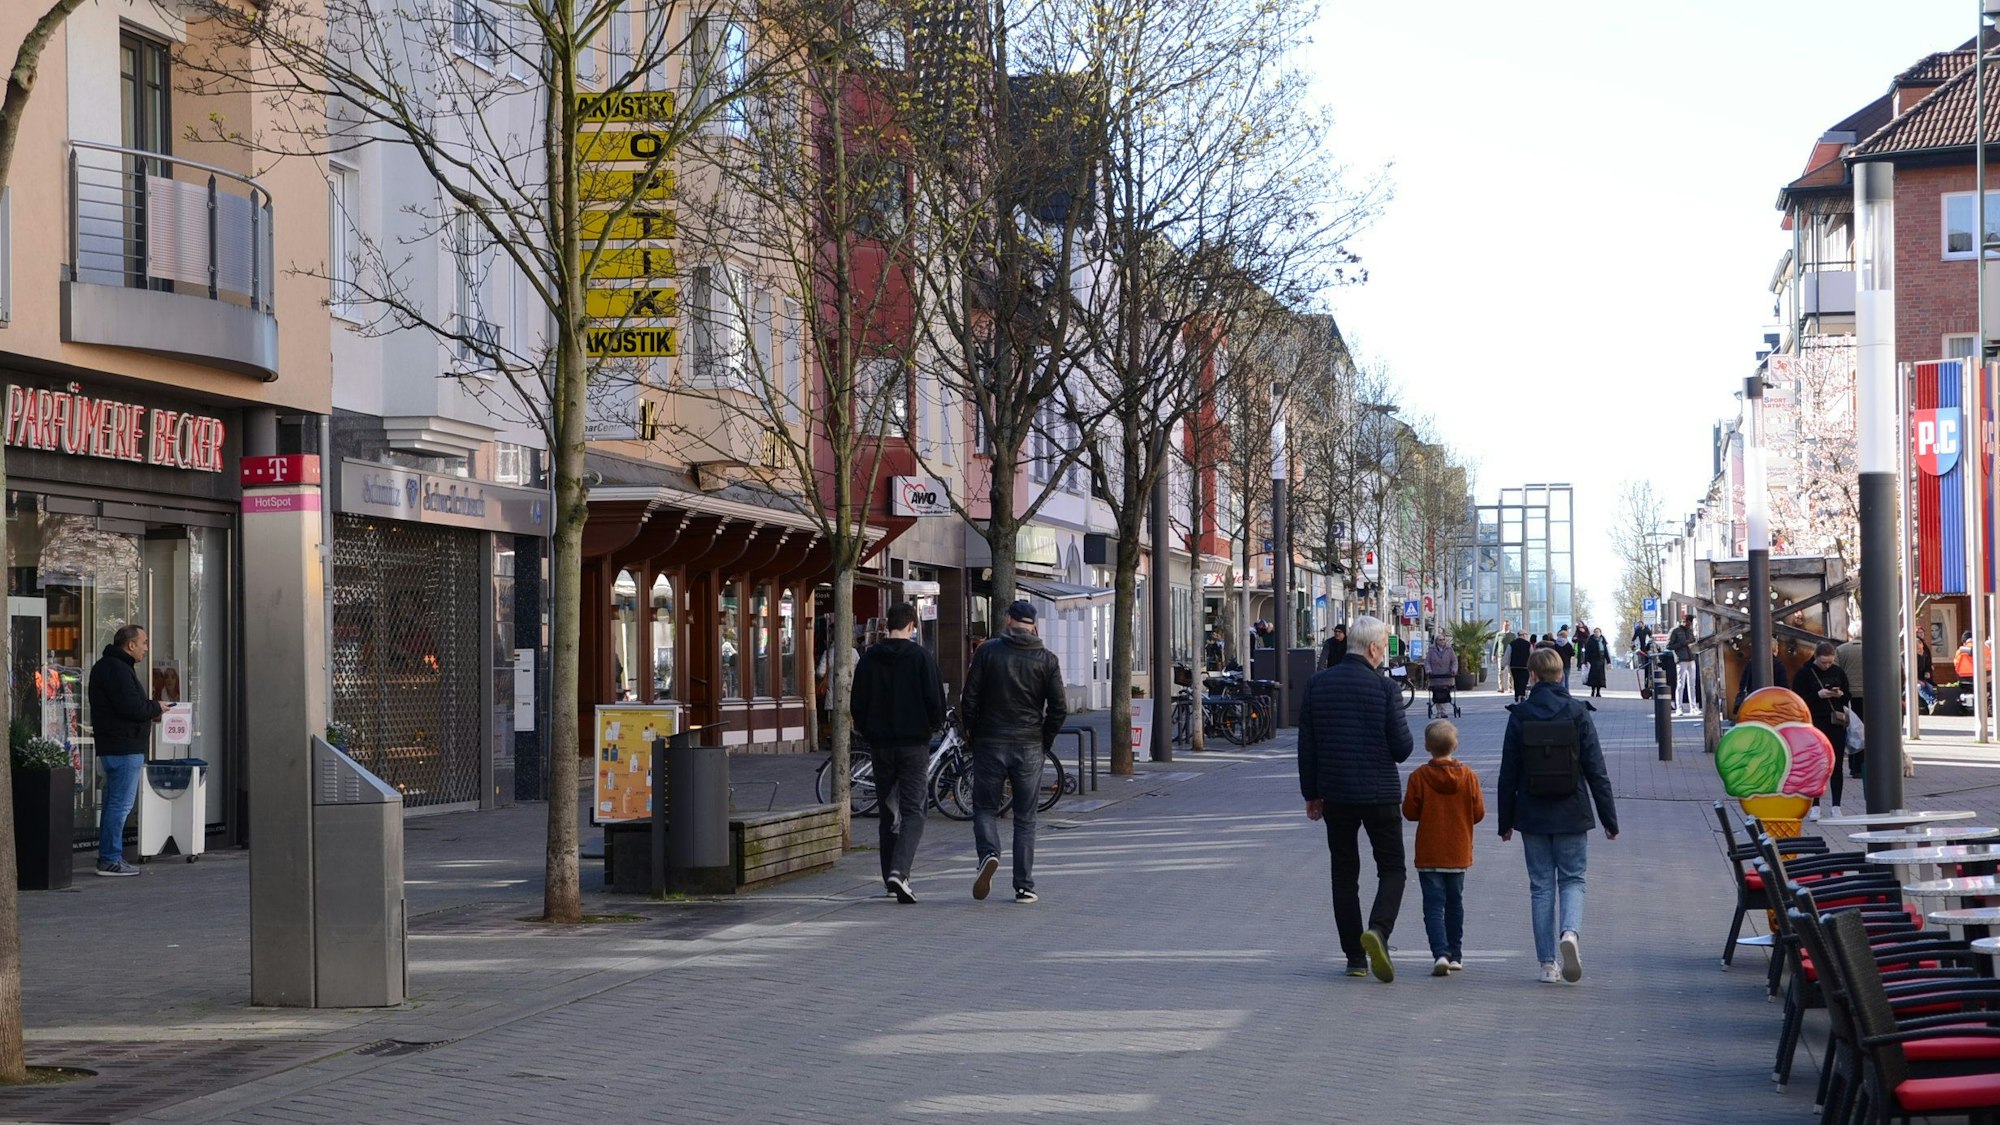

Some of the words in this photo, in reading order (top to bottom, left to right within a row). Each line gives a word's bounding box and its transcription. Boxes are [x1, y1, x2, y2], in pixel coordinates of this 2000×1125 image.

[4, 380, 147, 462] PARFÜMERIE
[148, 408, 228, 473] BECKER
[254, 496, 292, 508] HotSpot
[911, 491, 937, 505] AWO
[1645, 599, 1653, 609] P
